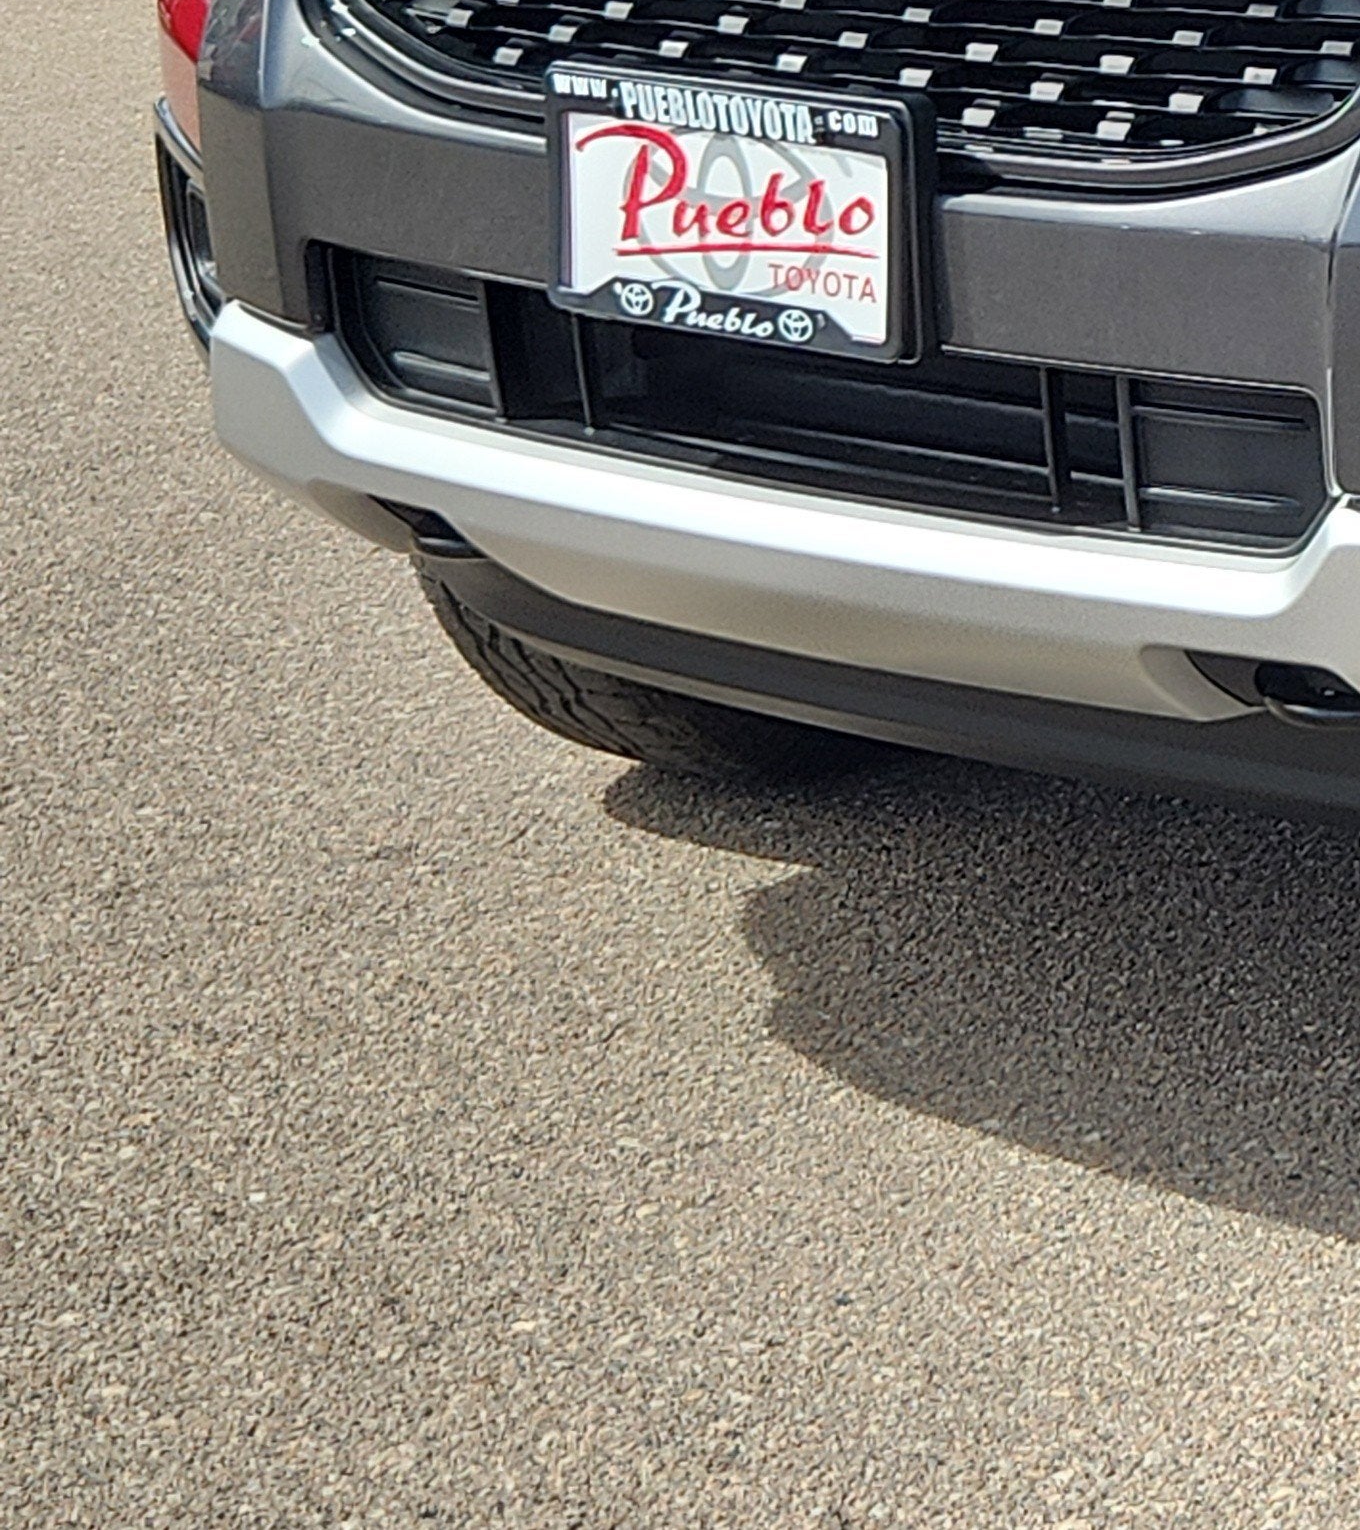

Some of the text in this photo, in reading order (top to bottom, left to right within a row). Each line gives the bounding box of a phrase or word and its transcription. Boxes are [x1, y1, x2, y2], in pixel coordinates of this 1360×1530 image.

[575, 124, 876, 242] Pueblo
[649, 279, 775, 338] Pueblo
[767, 263, 878, 303] TOYOTA
